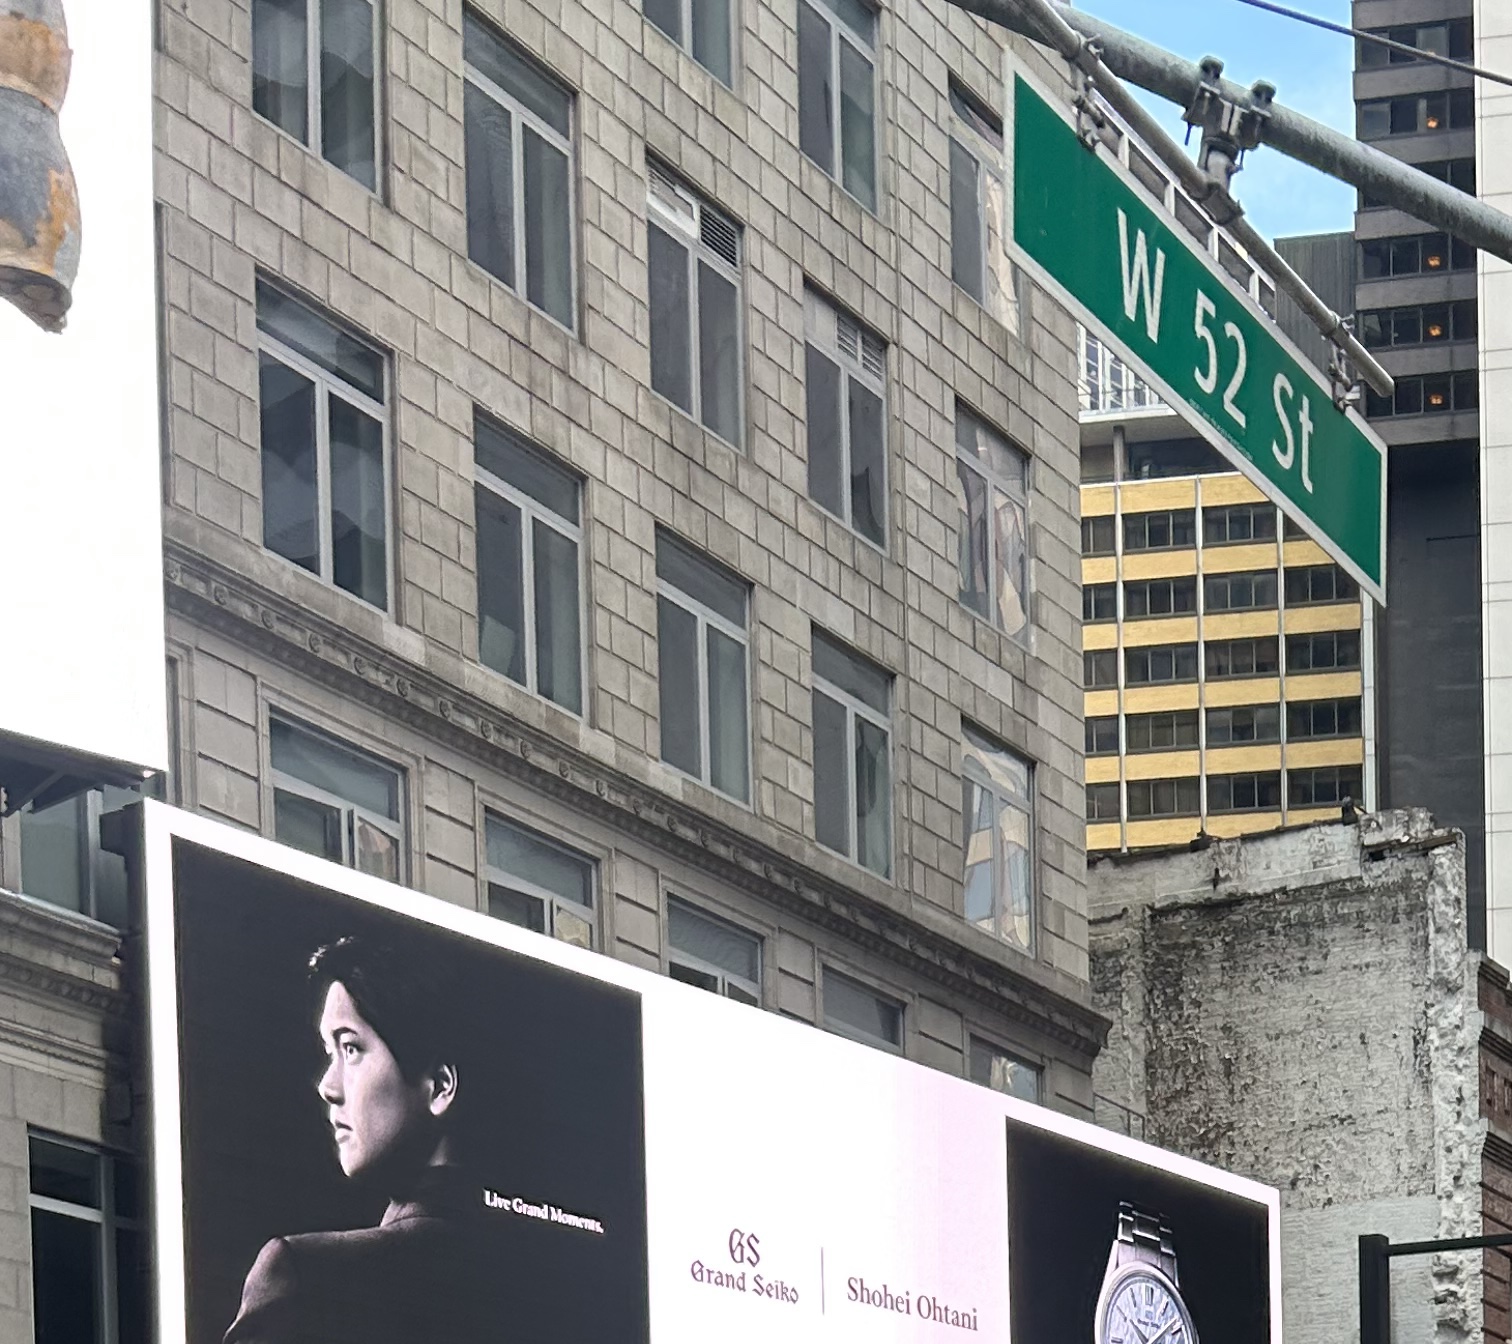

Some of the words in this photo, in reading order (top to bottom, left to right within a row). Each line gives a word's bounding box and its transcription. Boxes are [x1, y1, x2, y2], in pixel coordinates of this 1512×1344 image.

[1117, 207, 1165, 343] W
[1193, 288, 1247, 427] 52
[1272, 372, 1314, 494] St
[485, 1190, 511, 1211] Live
[512, 1198, 549, 1219] Grand
[550, 1206, 604, 1233] Moments.
[729, 1228, 761, 1267] GS
[690, 1260, 747, 1292] Grand
[752, 1274, 799, 1304] Seiko
[847, 1276, 911, 1315] Shohei
[917, 1295, 978, 1331] Ohtani
